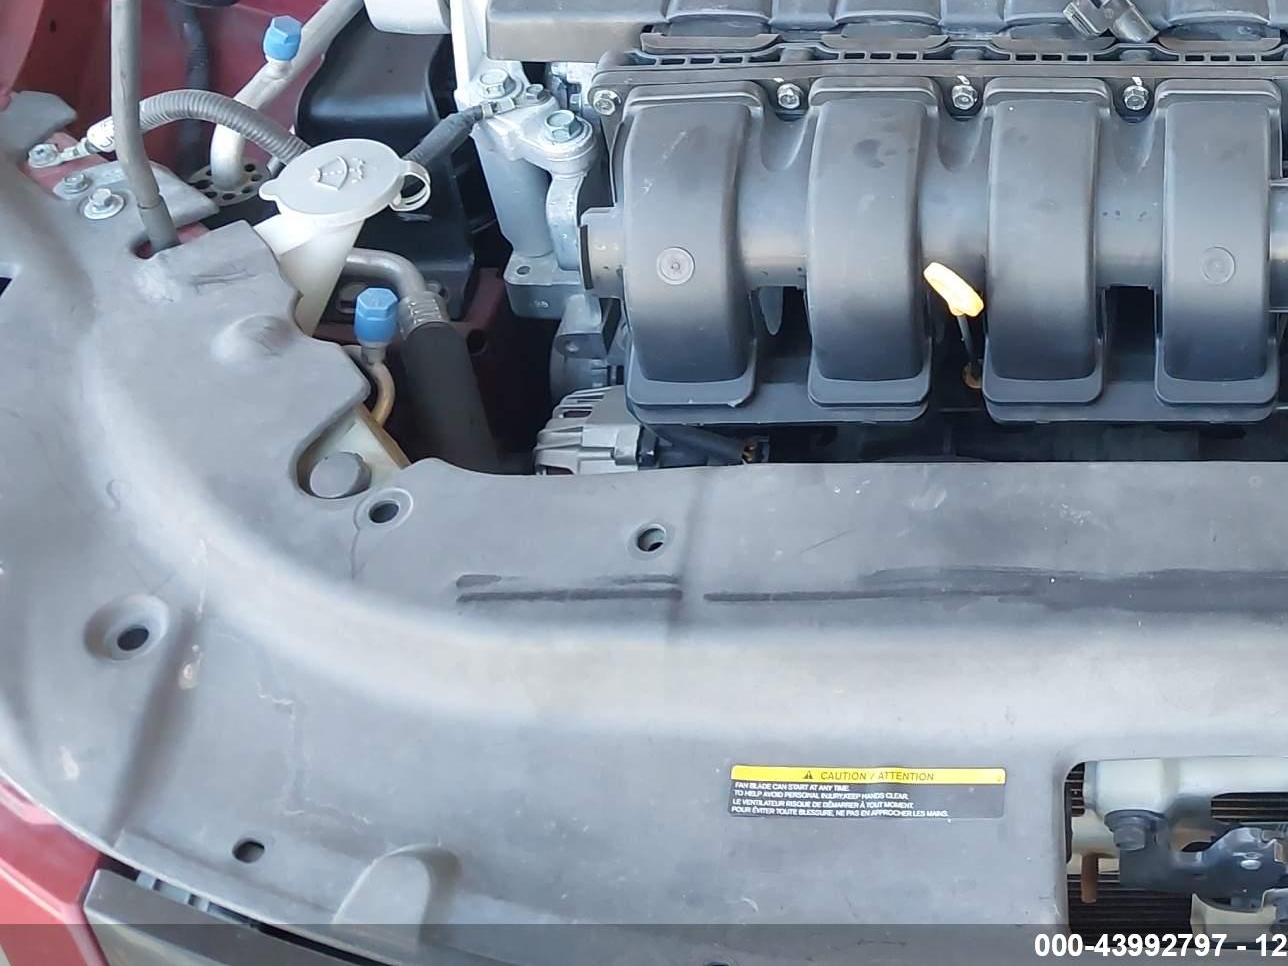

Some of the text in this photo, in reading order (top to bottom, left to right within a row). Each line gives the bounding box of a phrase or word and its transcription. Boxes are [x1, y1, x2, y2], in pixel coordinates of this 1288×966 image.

[820, 771, 867, 781] CAUTION
[878, 772, 934, 781] ATTENTION
[749, 782, 771, 790] BLADE
[784, 791, 820, 799] PERSONAL
[822, 800, 858, 809] DÉMARRER
[752, 806, 775, 814] ÉVITER
